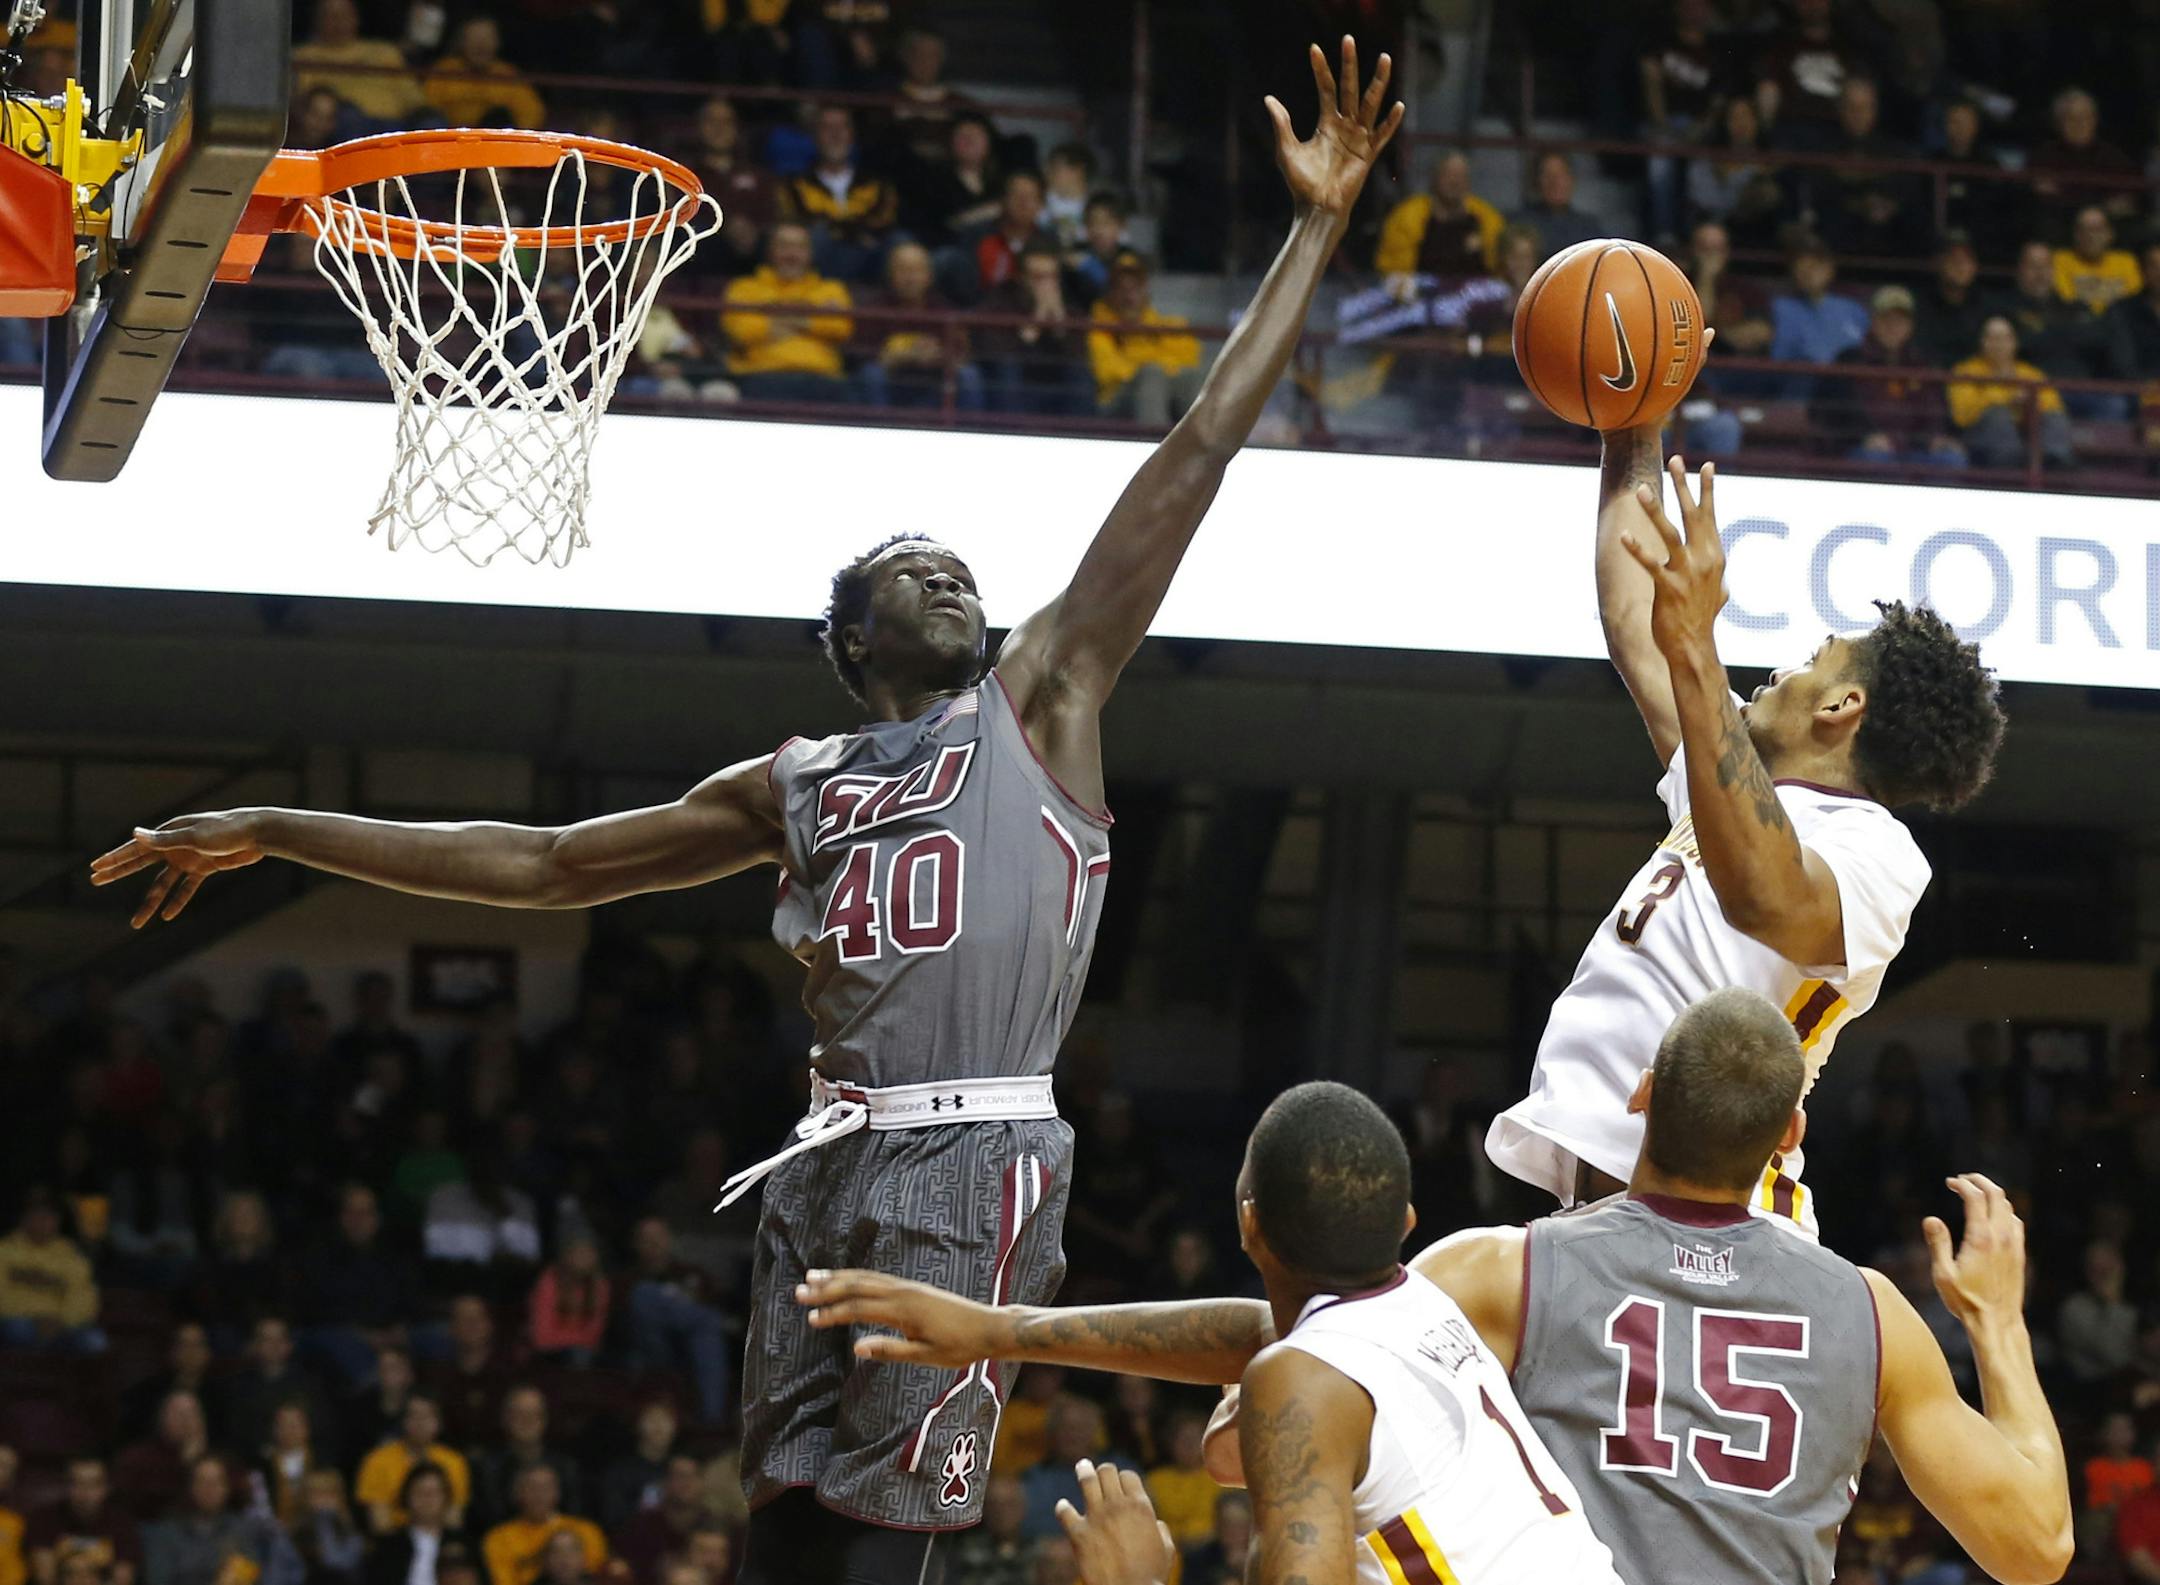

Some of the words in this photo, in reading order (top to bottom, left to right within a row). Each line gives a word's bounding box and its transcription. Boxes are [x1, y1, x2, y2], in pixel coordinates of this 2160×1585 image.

[1662, 299, 1689, 386] ELITE
[1717, 515, 2160, 652] CCOR
[812, 741, 976, 855] SIU
[816, 829, 965, 964] 40
[1616, 862, 1686, 948] 3
[889, 1102, 927, 1114] UNDER
[1673, 1244, 1734, 1276] VALLEY
[1695, 1243, 1714, 1255] THE
[1599, 1294, 1810, 1498] 15
[1478, 1384, 1571, 1517] 1
